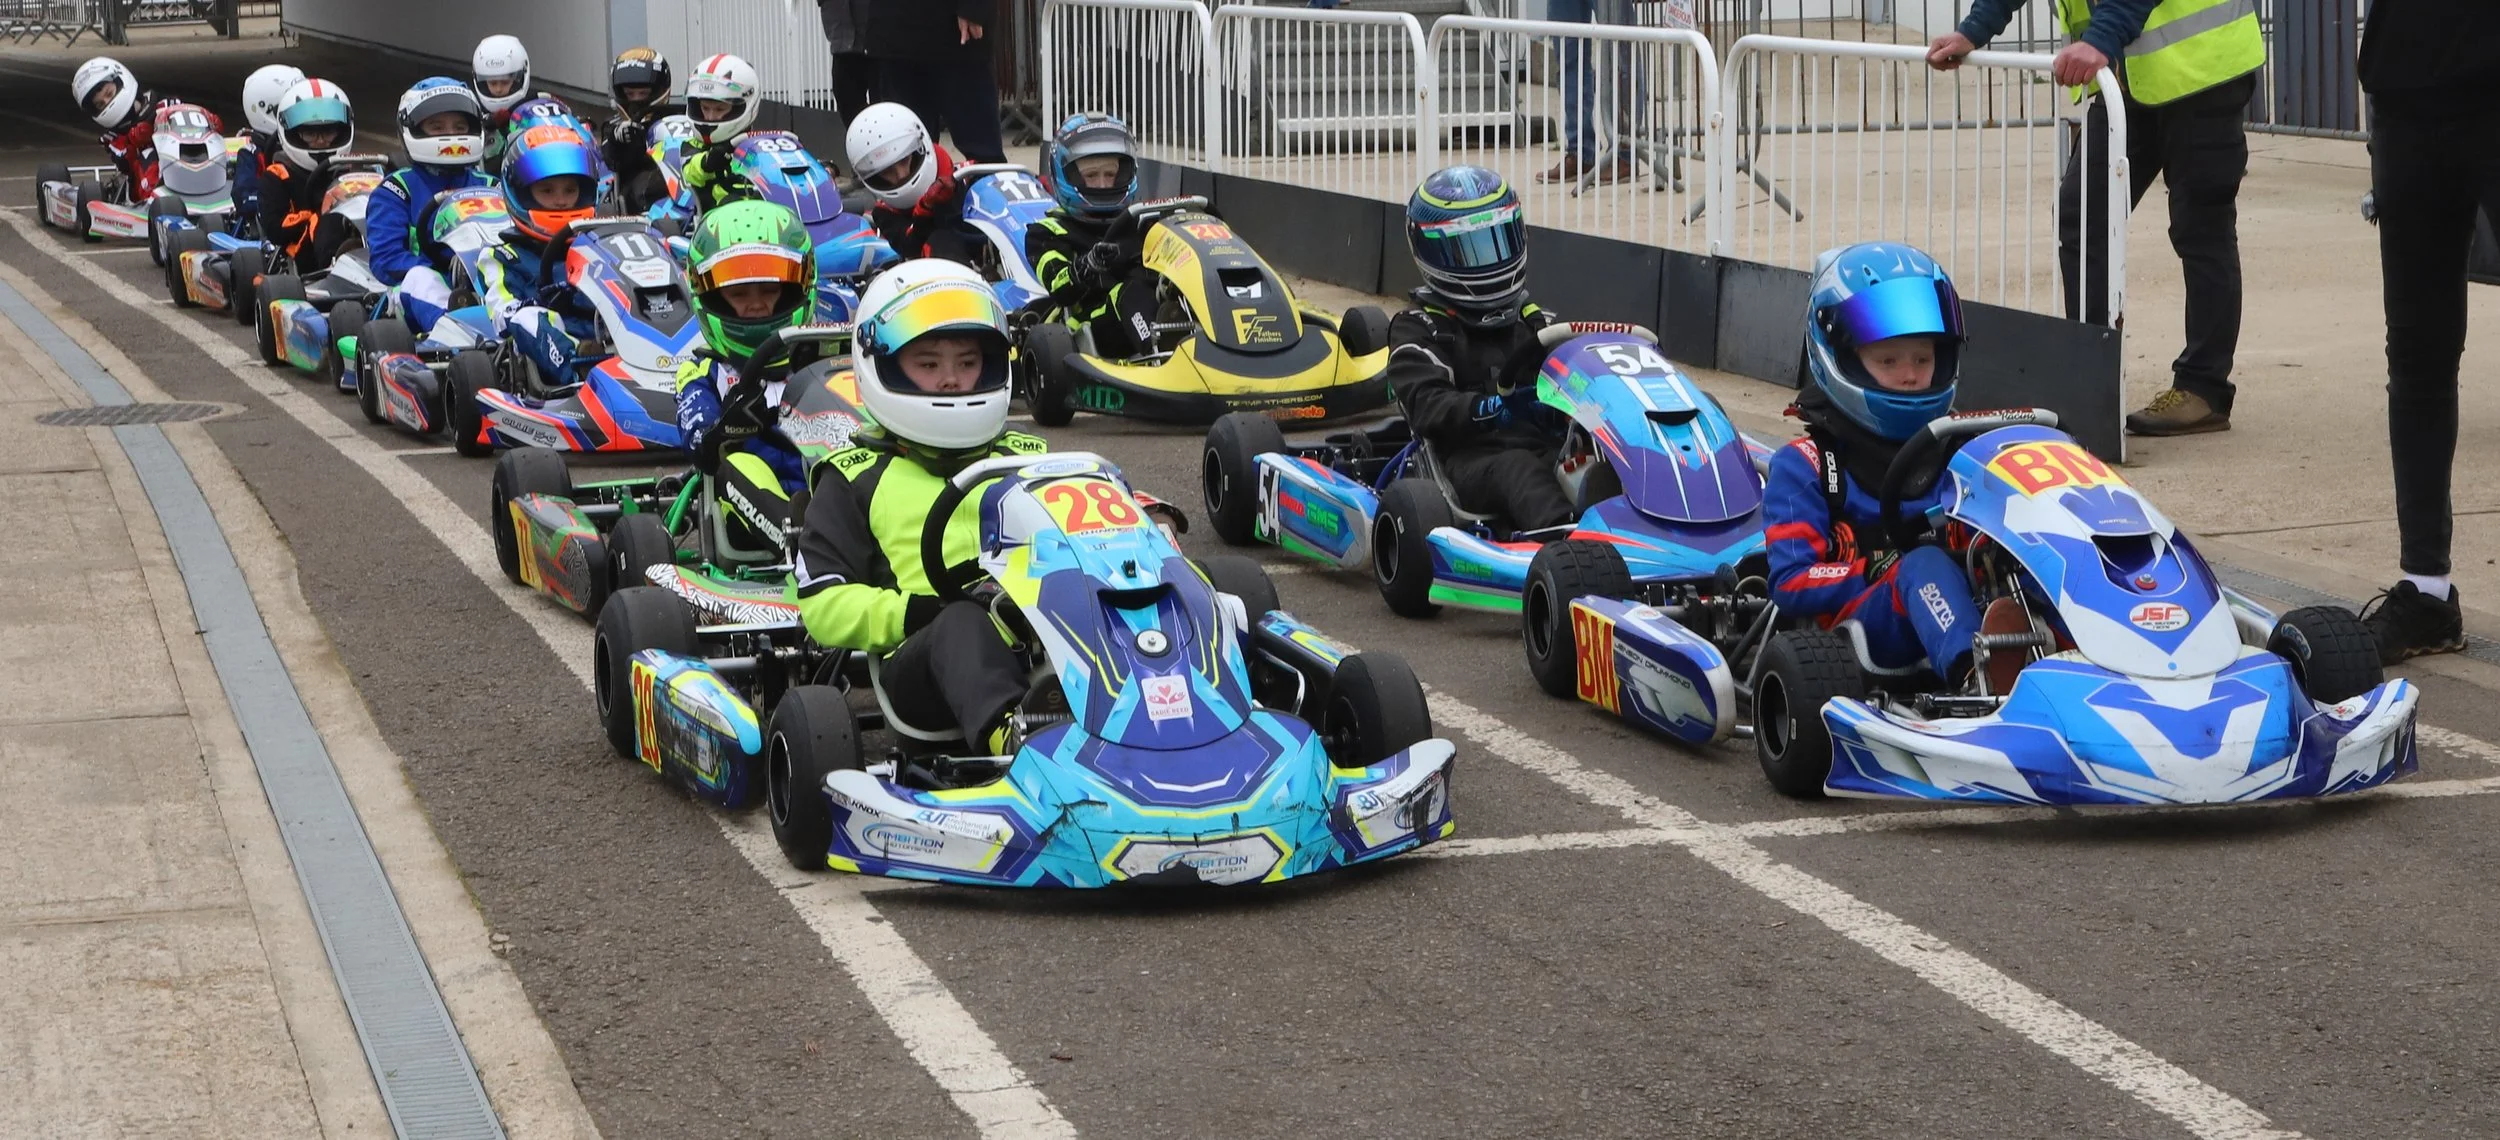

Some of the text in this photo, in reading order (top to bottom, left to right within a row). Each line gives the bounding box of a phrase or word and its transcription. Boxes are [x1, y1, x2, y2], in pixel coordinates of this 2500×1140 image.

[168, 111, 209, 128] 10
[532, 103, 560, 117] 07
[758, 138, 797, 152] 89
[1000, 180, 1041, 200] 17
[1189, 224, 1230, 240] 20
[609, 233, 655, 259] 11
[1569, 322, 1635, 334] WRIGHT
[1596, 344, 1676, 375] 54
[836, 450, 871, 470] OMP
[1998, 443, 2122, 497] BM
[1824, 450, 1839, 494] BENGO
[1043, 482, 1140, 534] 28
[1258, 461, 1281, 546] 54
[1306, 501, 1339, 537] GMS
[1452, 558, 1494, 577] GMS
[1918, 582, 1956, 634] sparco
[2131, 605, 2187, 622] JSF
[1573, 606, 1621, 716] BM
[1614, 642, 1691, 690] JENSON DRUMMOND
[850, 800, 881, 819] KNOX
[877, 830, 945, 850] AMBITION
[1183, 855, 1249, 869] MBITION
